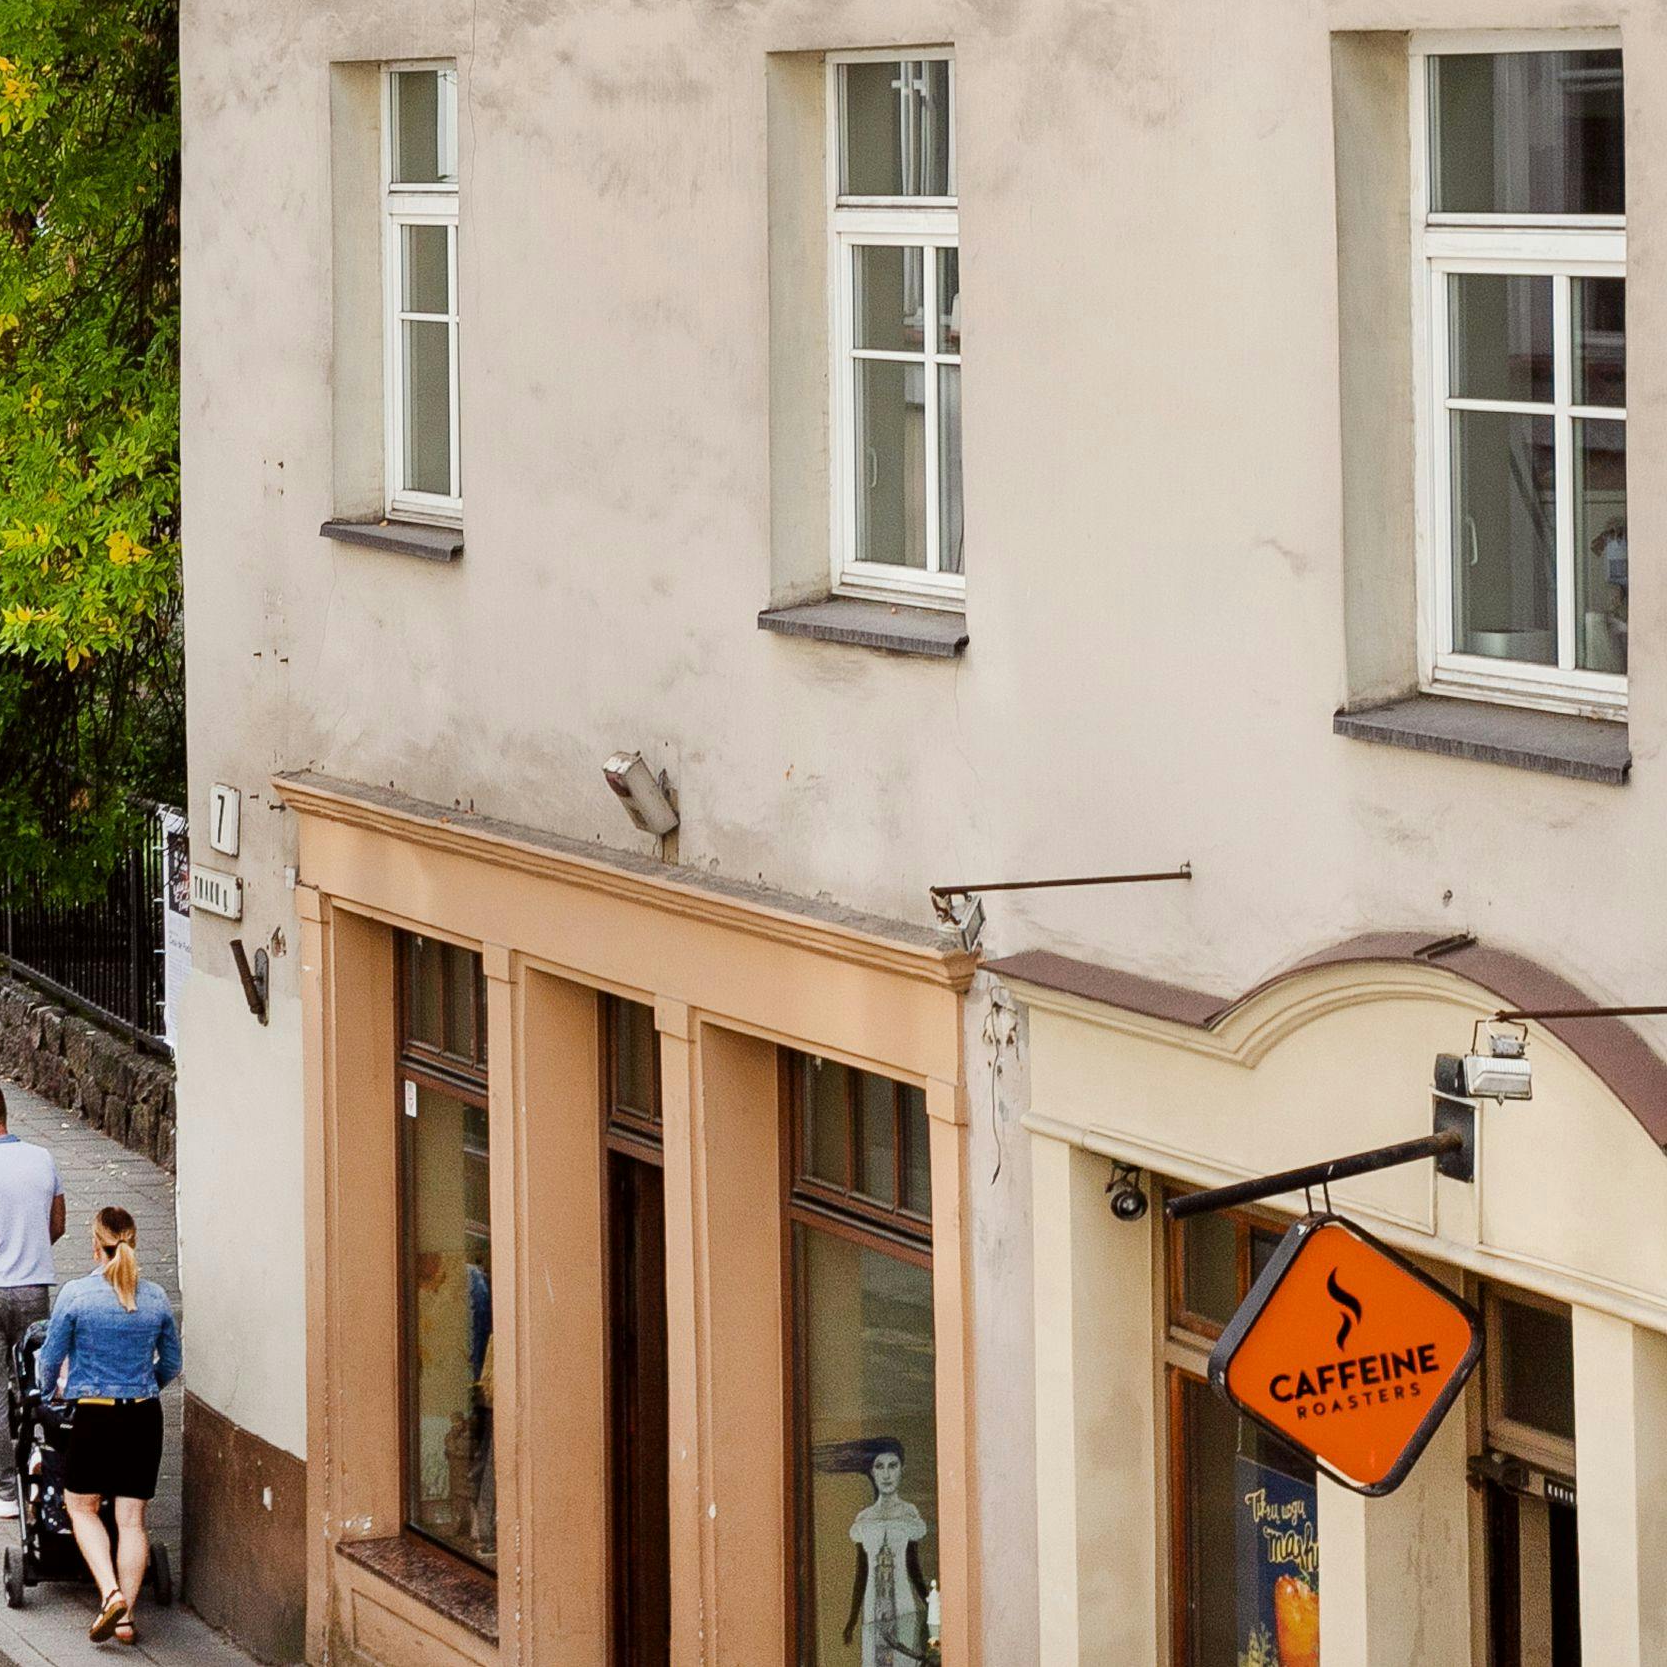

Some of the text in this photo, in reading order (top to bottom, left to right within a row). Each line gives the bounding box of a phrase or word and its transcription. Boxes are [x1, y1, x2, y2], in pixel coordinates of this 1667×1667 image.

[217, 794, 225, 844] 7
[1269, 1342, 1440, 1403] CAFFEINE
[1296, 1381, 1421, 1420] ROASTERS
